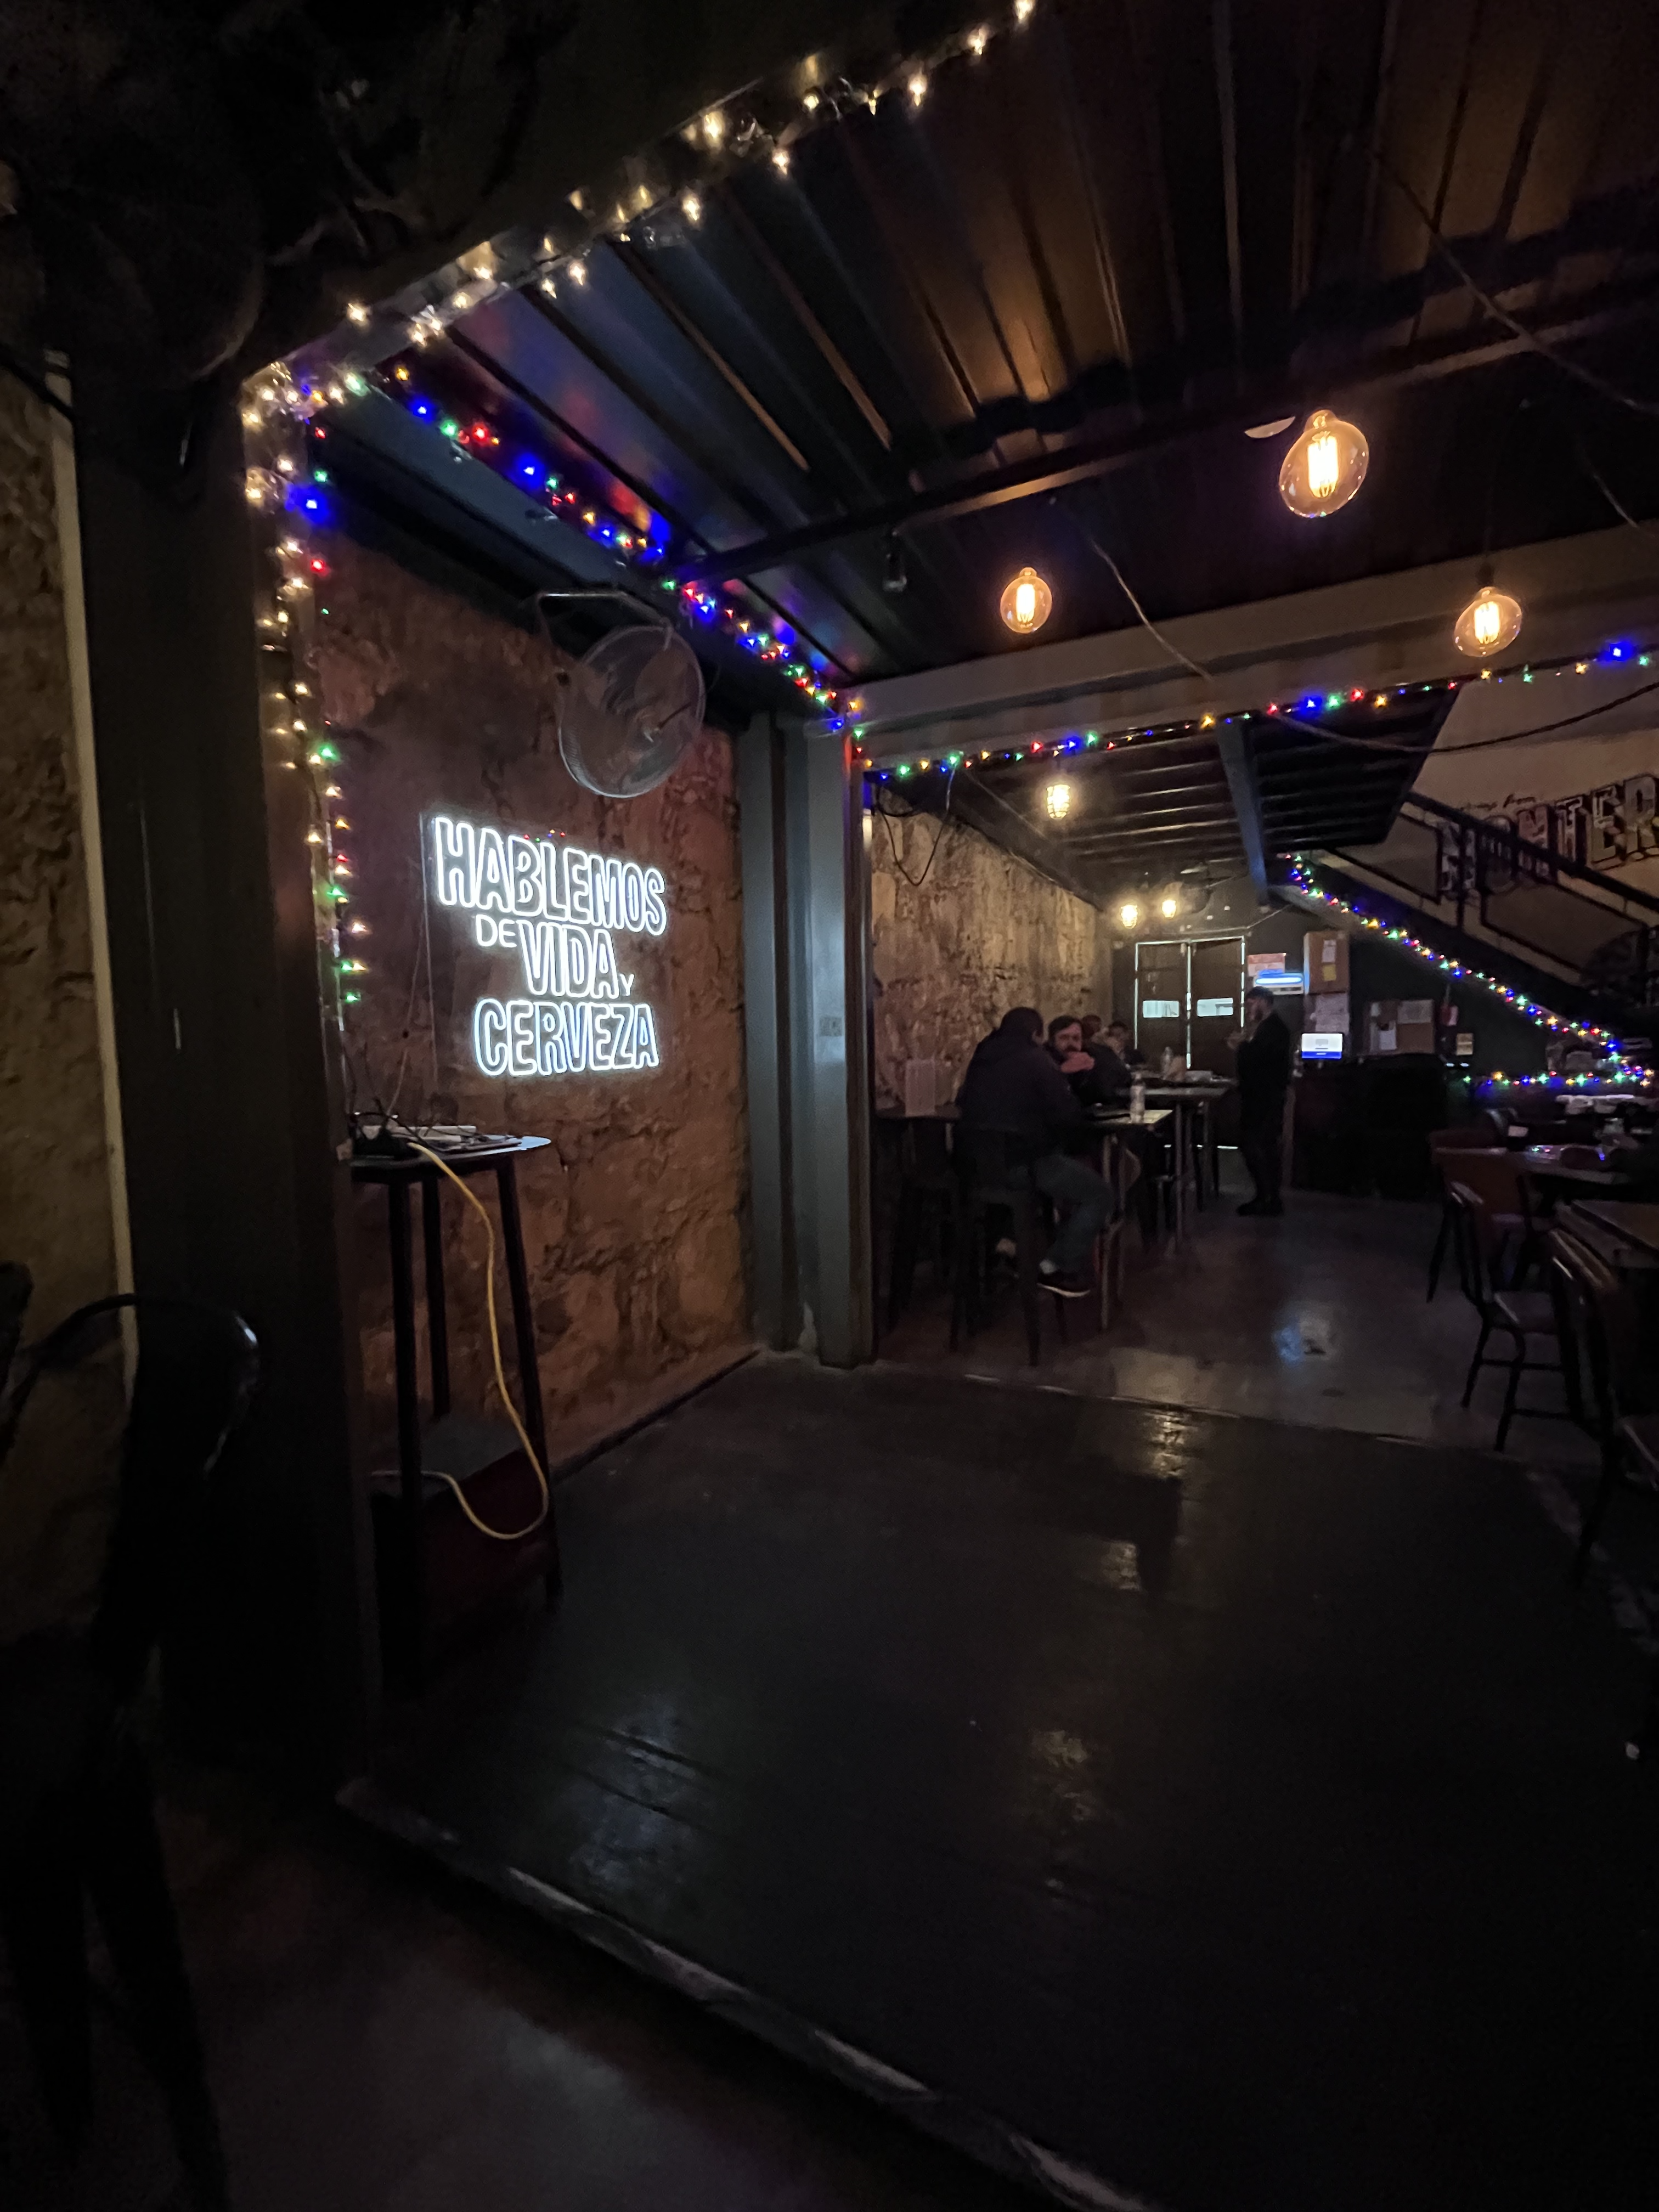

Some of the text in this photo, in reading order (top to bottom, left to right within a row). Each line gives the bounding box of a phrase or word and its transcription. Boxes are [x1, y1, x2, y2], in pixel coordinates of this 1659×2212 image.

[434, 816, 667, 936] HABLEMOS
[475, 913, 635, 999] DE VIDA Y
[473, 998, 660, 1076] CERVEZA
